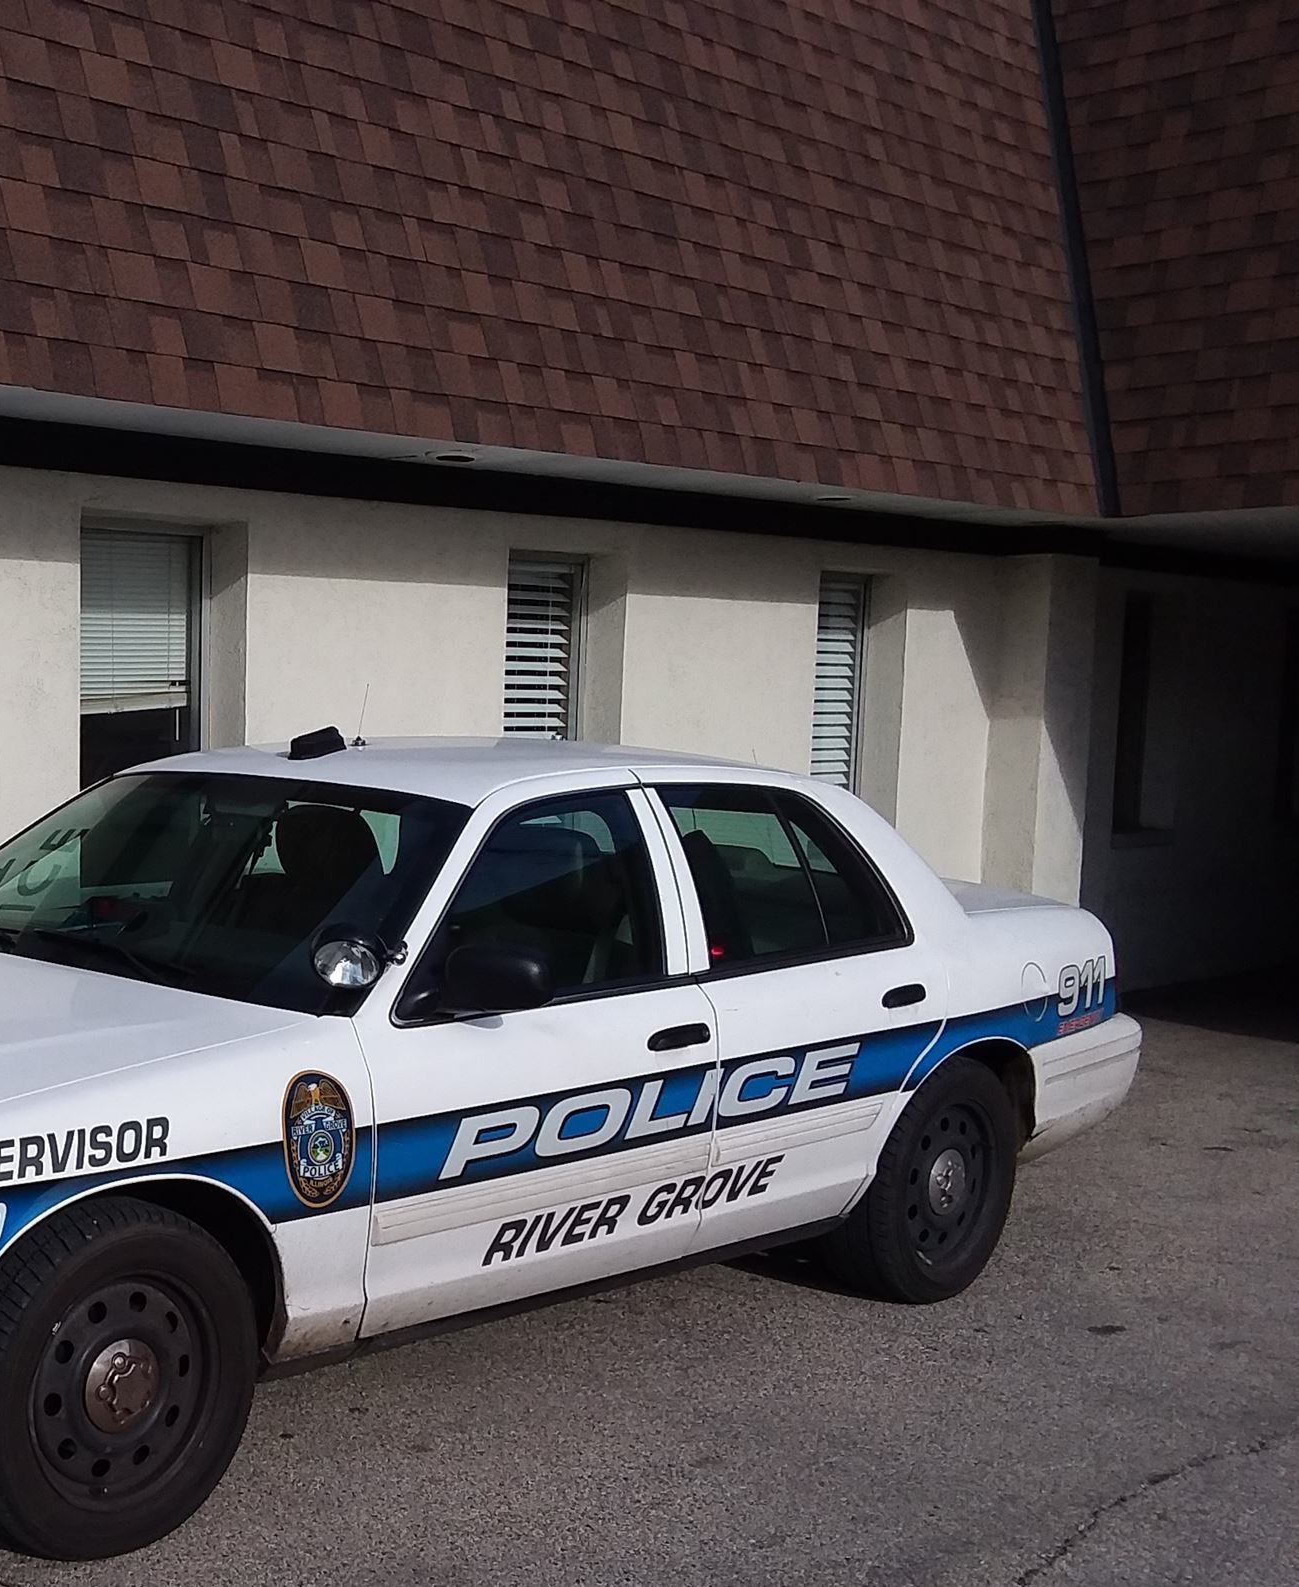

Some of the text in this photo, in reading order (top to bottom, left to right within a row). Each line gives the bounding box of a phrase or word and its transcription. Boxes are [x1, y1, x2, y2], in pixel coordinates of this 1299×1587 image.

[1057, 955, 1106, 1016] 911
[292, 1119, 347, 1136] RIVER GROVE
[438, 1042, 862, 1181] POLICE
[303, 1161, 340, 1177] POLICE
[482, 1154, 785, 1268] RIVER GROVE
